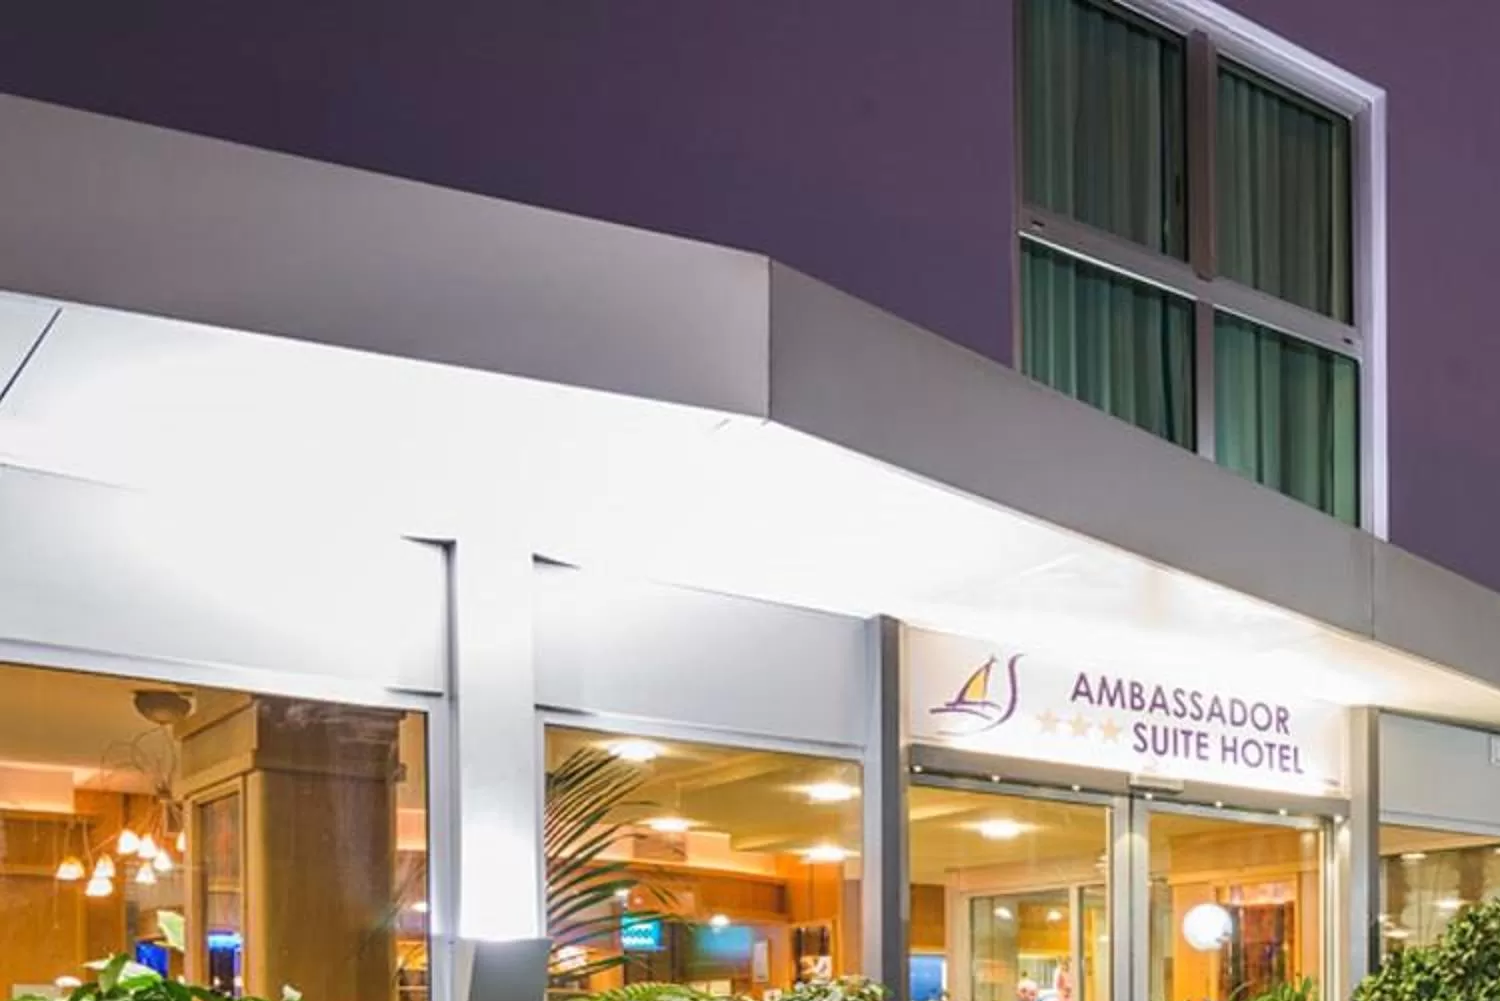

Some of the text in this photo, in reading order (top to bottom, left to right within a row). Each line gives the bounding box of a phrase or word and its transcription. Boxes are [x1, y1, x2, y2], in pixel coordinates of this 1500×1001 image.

[1070, 671, 1291, 736] AMBASSADOR
[1132, 721, 1304, 775] SUITE HOTEL
